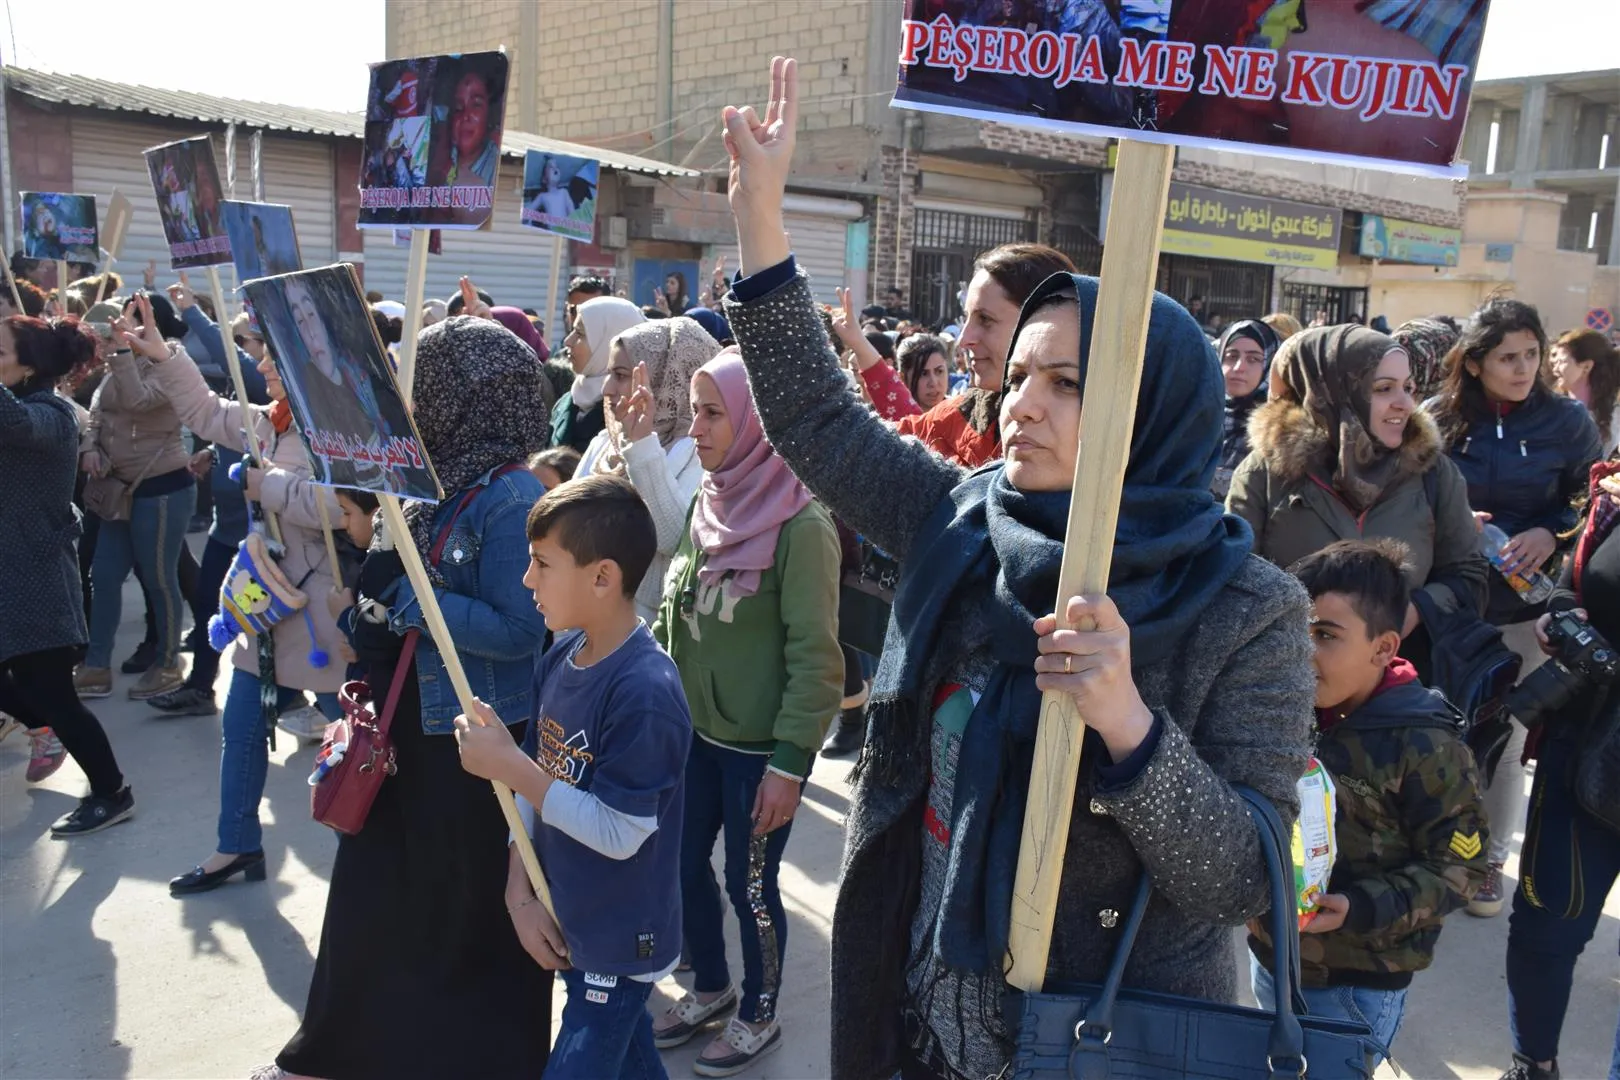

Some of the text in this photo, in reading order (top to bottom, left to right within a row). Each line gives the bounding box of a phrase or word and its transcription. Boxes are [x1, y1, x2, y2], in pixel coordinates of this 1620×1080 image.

[900, 14, 1468, 121] PÊŞEROJA ME NE KUJIN
[360, 185, 494, 213] PÊŞEROJA ME NE KUJIN
[1170, 190, 1190, 222] أبو
[1271, 214, 1301, 239] عبدي
[1302, 213, 1333, 240] شركة
[402, 435, 425, 469] لا
